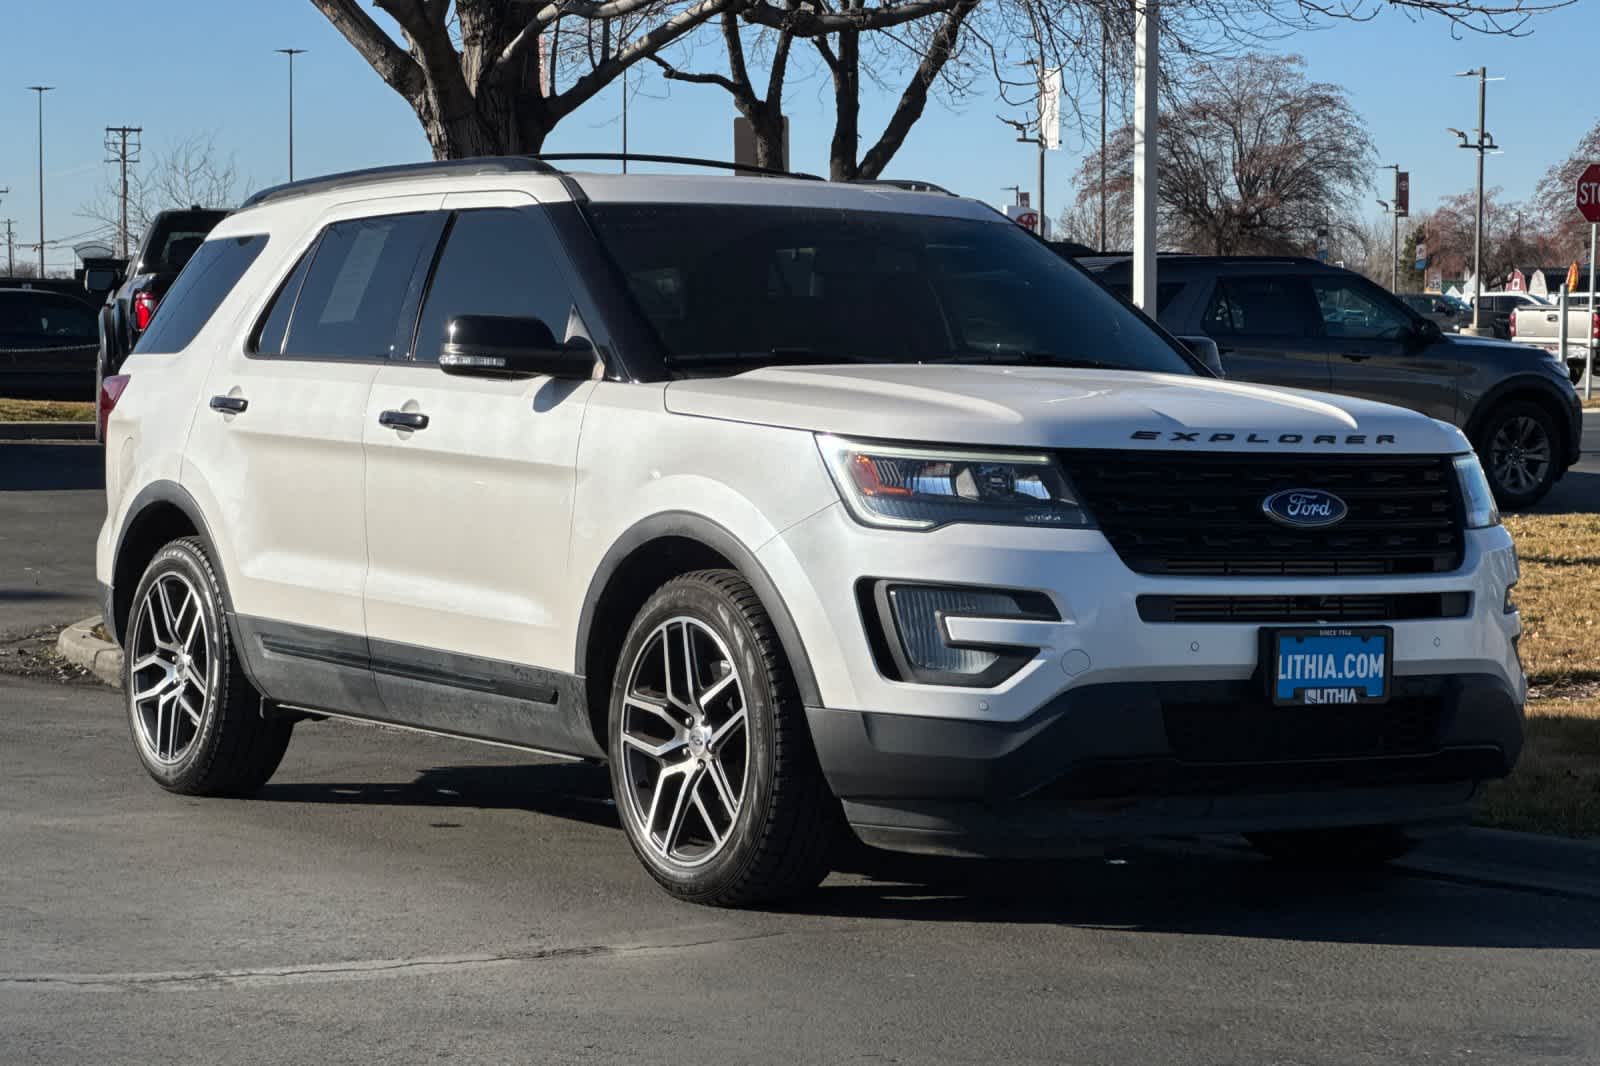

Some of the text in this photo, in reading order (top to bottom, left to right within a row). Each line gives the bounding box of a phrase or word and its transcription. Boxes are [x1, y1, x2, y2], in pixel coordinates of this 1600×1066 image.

[1580, 182, 1600, 204] ST
[1130, 430, 1396, 445] EXPLORER
[1288, 493, 1331, 516] Ford
[1278, 653, 1384, 680] LITHIA.COM
[1317, 687, 1357, 704] LITHIA
